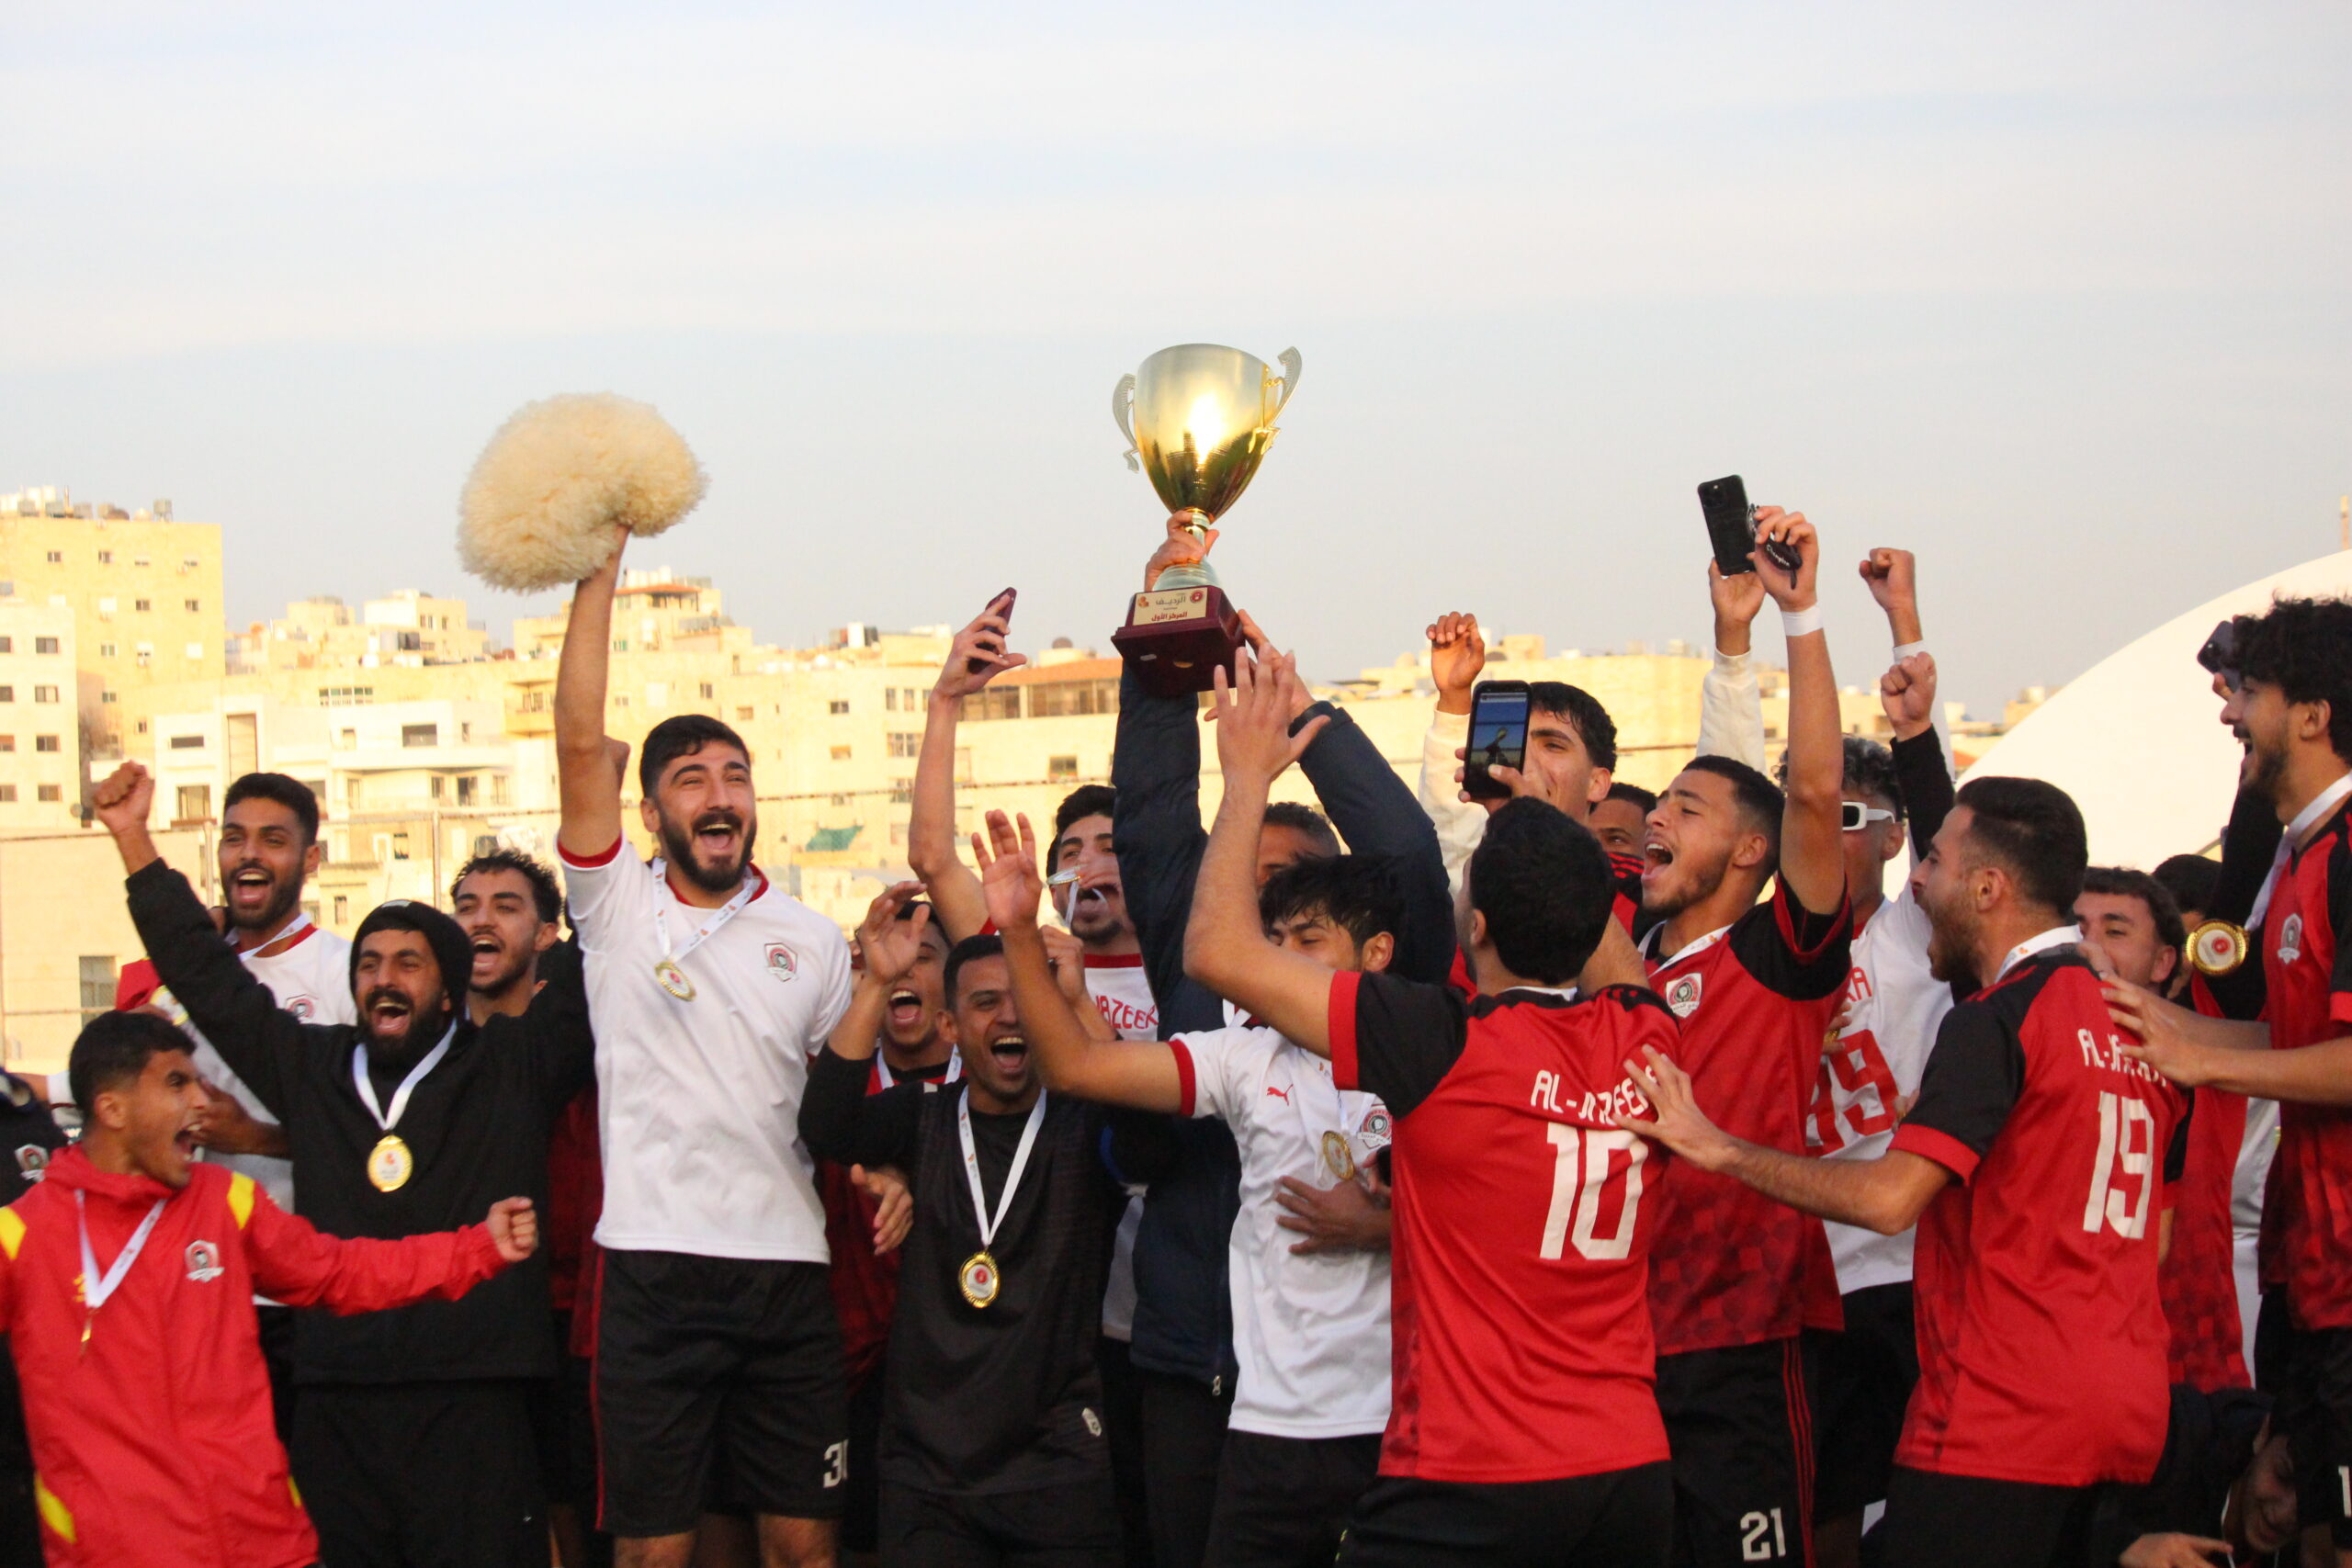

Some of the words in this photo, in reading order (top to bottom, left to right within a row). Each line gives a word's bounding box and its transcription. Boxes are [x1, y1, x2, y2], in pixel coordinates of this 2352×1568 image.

[1169, 611, 1188, 620] المركز
[1539, 1122, 1649, 1260] 10
[2083, 1089, 2154, 1239] 19
[1740, 1507, 1786, 1561] 21
